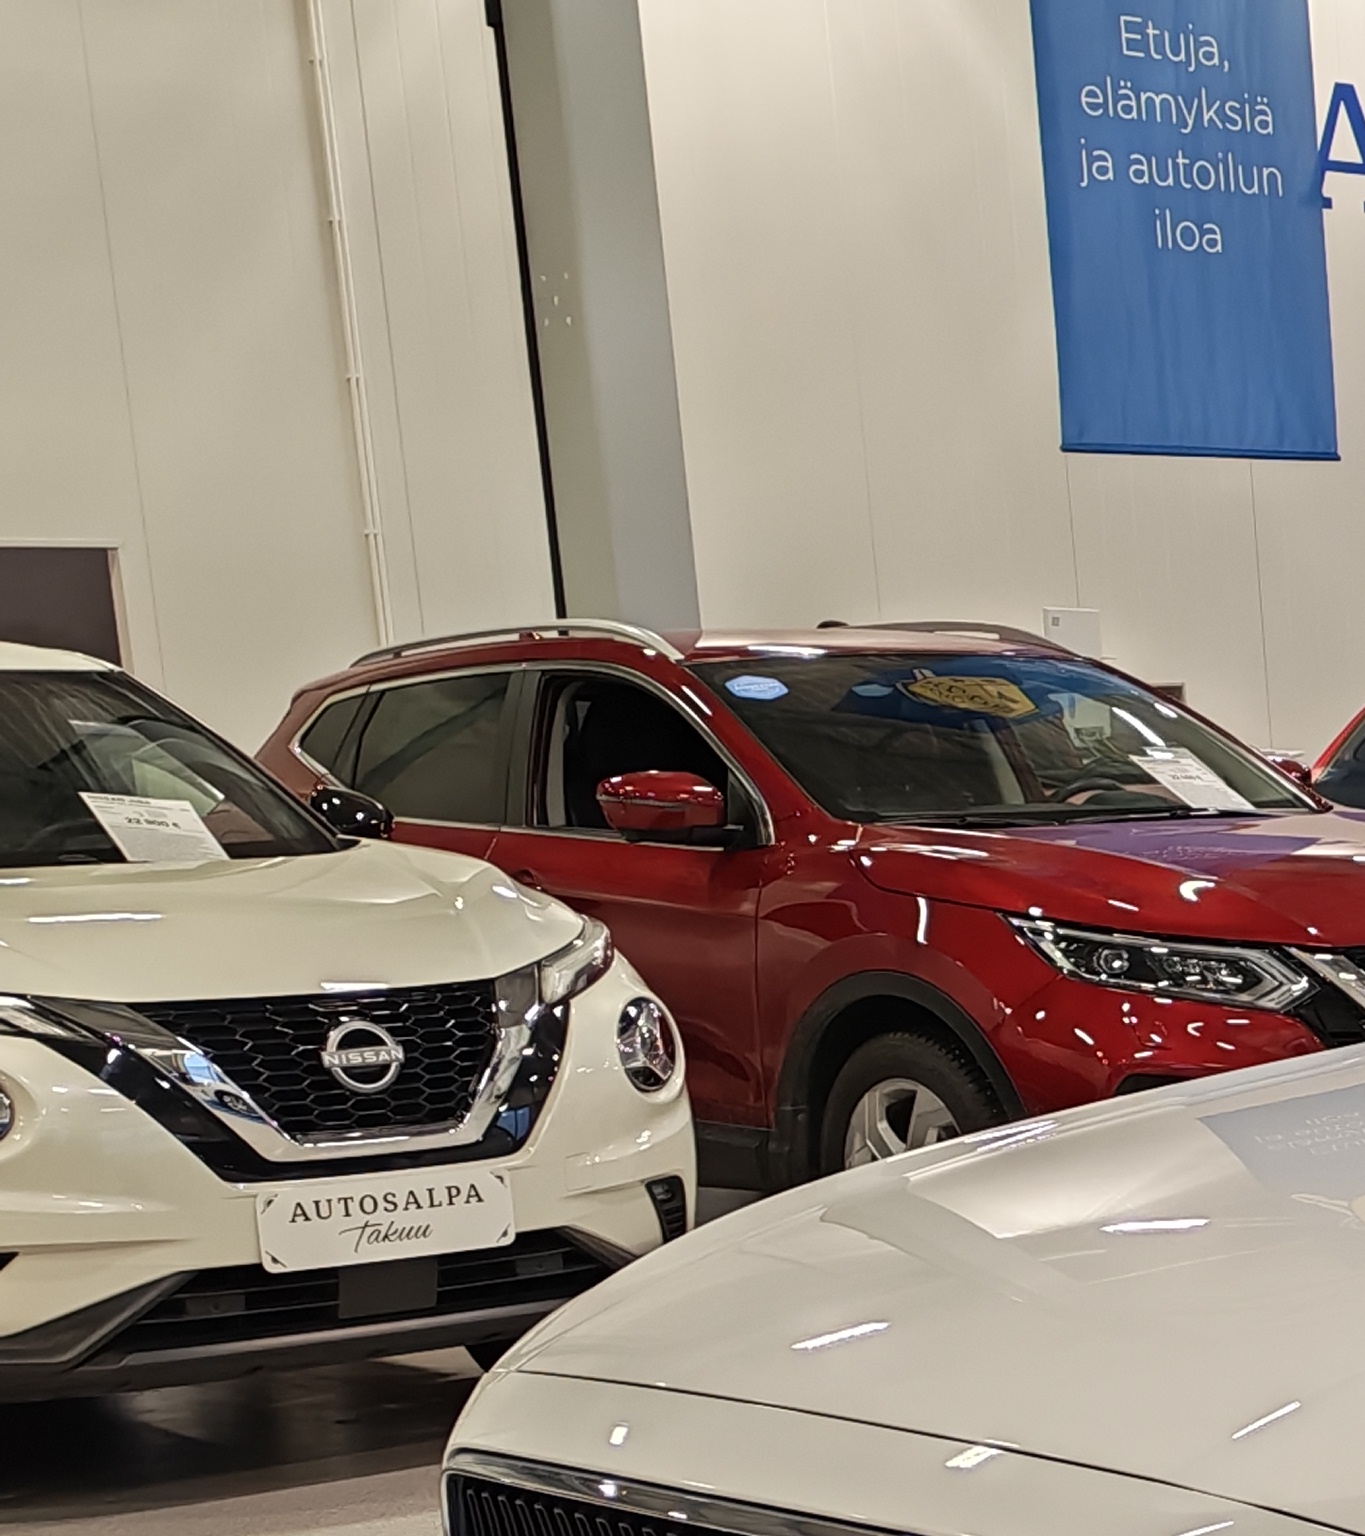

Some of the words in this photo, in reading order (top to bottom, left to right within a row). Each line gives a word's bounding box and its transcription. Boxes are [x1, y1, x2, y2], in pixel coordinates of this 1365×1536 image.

[1119, 15, 1230, 72] Etuja,
[1080, 75, 1273, 135] elämyksiä
[1079, 138, 1114, 187] ja
[1129, 150, 1283, 197] autoilun
[1154, 208, 1222, 253] iloa
[324, 1049, 402, 1066] NISSAN
[288, 1183, 485, 1223] AUTOSALPA
[338, 1219, 433, 1254] Takuu
